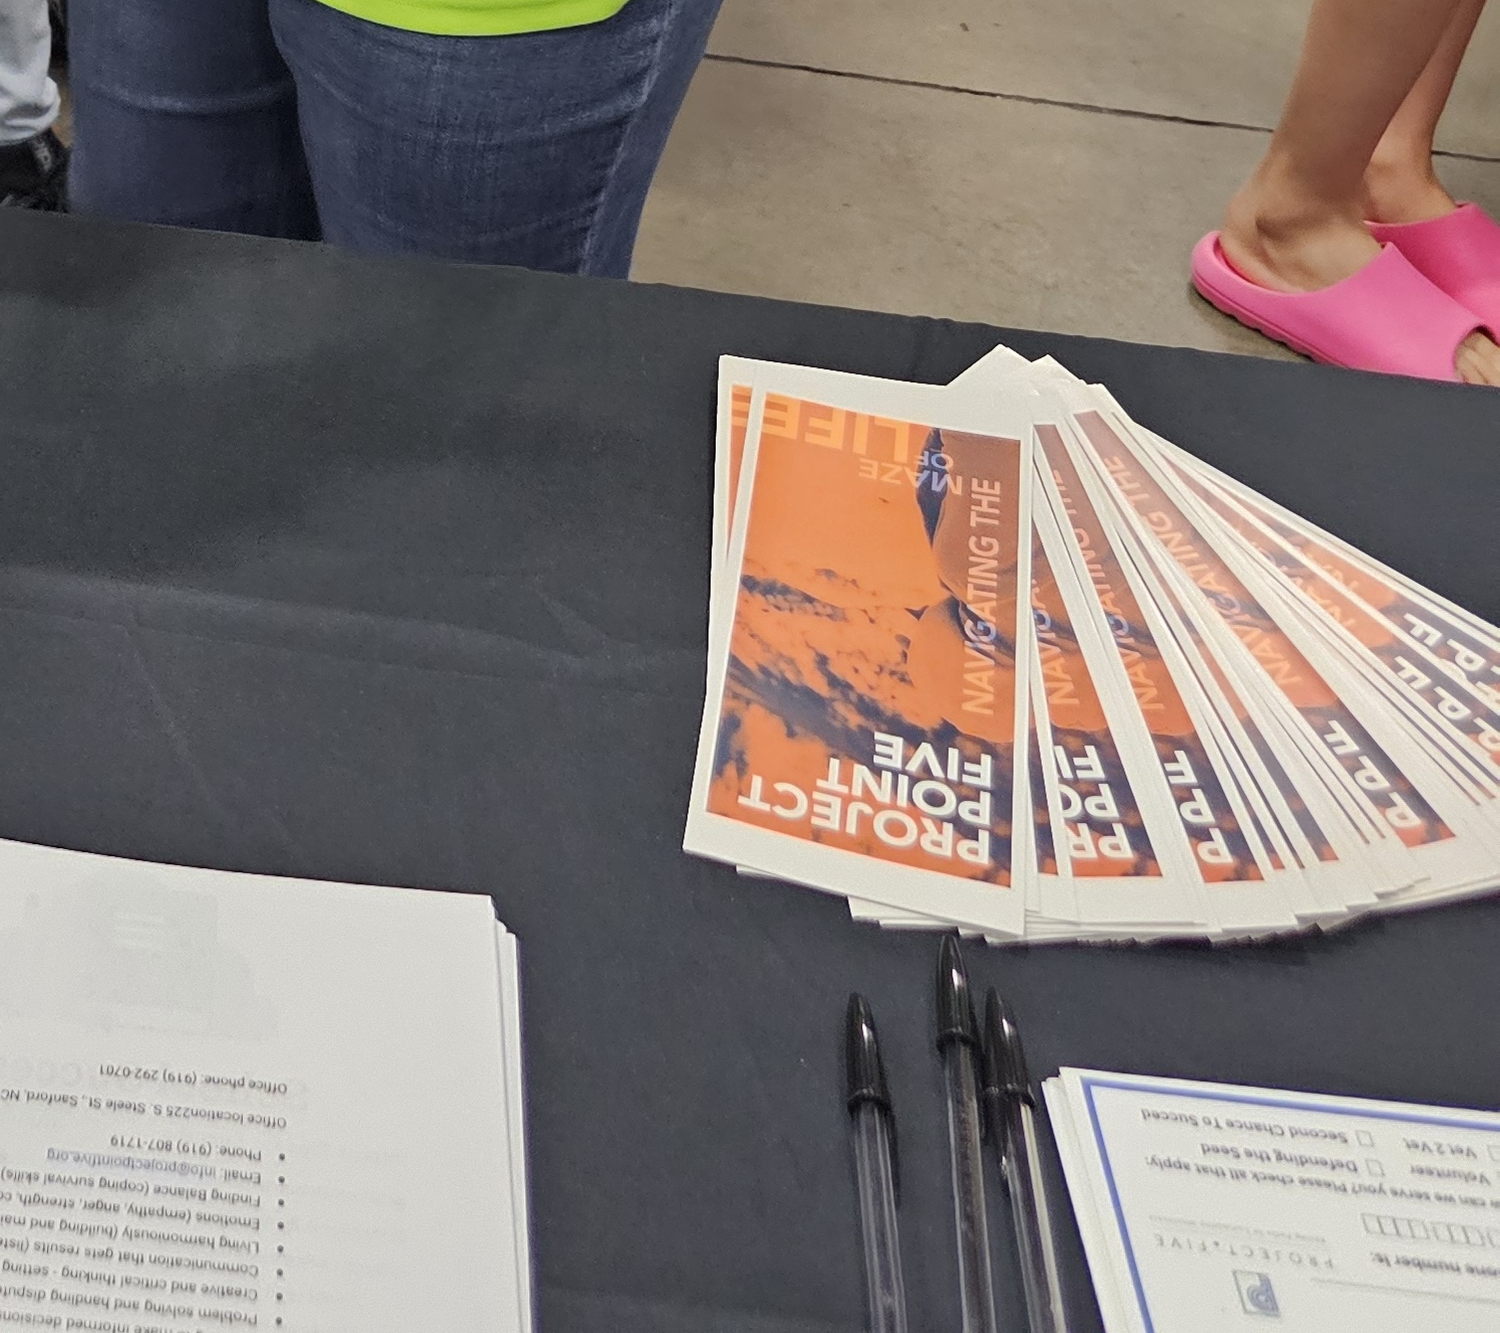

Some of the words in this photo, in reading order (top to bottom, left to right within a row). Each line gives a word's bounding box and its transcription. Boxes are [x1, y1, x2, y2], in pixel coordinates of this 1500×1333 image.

[762, 391, 911, 465] LIFE
[914, 447, 954, 471] OF
[857, 456, 963, 496] MAZE
[968, 477, 1002, 529] THE
[960, 535, 1001, 716] NAVIGATING
[872, 731, 994, 791] FIVE
[815, 755, 994, 826] POINT
[737, 774, 993, 867] PROJECT
[162, 1069, 198, 1085] (919)
[200, 1073, 245, 1090] phone:
[0, 1088, 20, 1101] NC
[248, 1079, 288, 1094] Office
[23, 1089, 78, 1107] Sanford,
[80, 1094, 102, 1109] St.,
[105, 1097, 146, 1114] Steele
[150, 1103, 162, 1115] S.
[166, 1105, 244, 1125] location225
[247, 1113, 287, 1129] Office
[1202, 1115, 1223, 1131] To
[1224, 1117, 1284, 1137] Chance
[110, 1134, 172, 1152] 807-1719
[1287, 1125, 1348, 1145] Second
[176, 1139, 212, 1156] (919)
[215, 1145, 262, 1161] Phone:
[1199, 1142, 1240, 1158] Seed
[1243, 1147, 1271, 1162] the
[1402, 1137, 1434, 1155] Vet
[1434, 1142, 1445, 1155] 2
[1447, 1143, 1477, 1160] Vet
[46, 1148, 216, 1179] info@projectpointfive.org
[1144, 1154, 1190, 1172] apply:
[1272, 1148, 1358, 1174] Defending
[0, 1166, 40, 1181] skills)
[220, 1167, 261, 1185] Email:
[1194, 1163, 1227, 1179] that
[1229, 1167, 1246, 1181] all
[1250, 1170, 1294, 1187] check
[1410, 1165, 1491, 1187] Volunteer
[44, 1173, 94, 1191] survival
[99, 1176, 150, 1196] (coping
[1298, 1177, 1348, 1195] Please
[1352, 1182, 1388, 1196] you?
[17, 1191, 75, 1210] strength,
[153, 1184, 206, 1201] Balance
[211, 1188, 261, 1207] Finding
[1390, 1189, 1431, 1201] serve
[1434, 1193, 1456, 1203] we
[1459, 1195, 1486, 1208] can
[78, 1199, 120, 1215] anger,
[124, 1203, 192, 1224] (empathy,
[30, 1217, 54, 1230] and
[59, 1217, 118, 1239] (building
[196, 1212, 260, 1231] Emotions
[122, 1225, 215, 1249] harmoniously
[219, 1235, 259, 1253] Living
[34, 1241, 80, 1257] results
[84, 1245, 113, 1261] gets
[118, 1251, 144, 1265] that
[2, 1259, 49, 1277] setting
[148, 1253, 258, 1277] Communication
[1394, 1255, 1460, 1273] number
[61, 1266, 116, 1286] thinking
[120, 1275, 166, 1292] critical
[171, 1281, 197, 1293] and
[200, 1283, 258, 1301] Creative
[50, 1289, 110, 1310] handling
[114, 1299, 140, 1313] and
[144, 1299, 194, 1319] solving
[198, 1308, 258, 1325] Problem
[66, 1317, 130, 1333] informed
